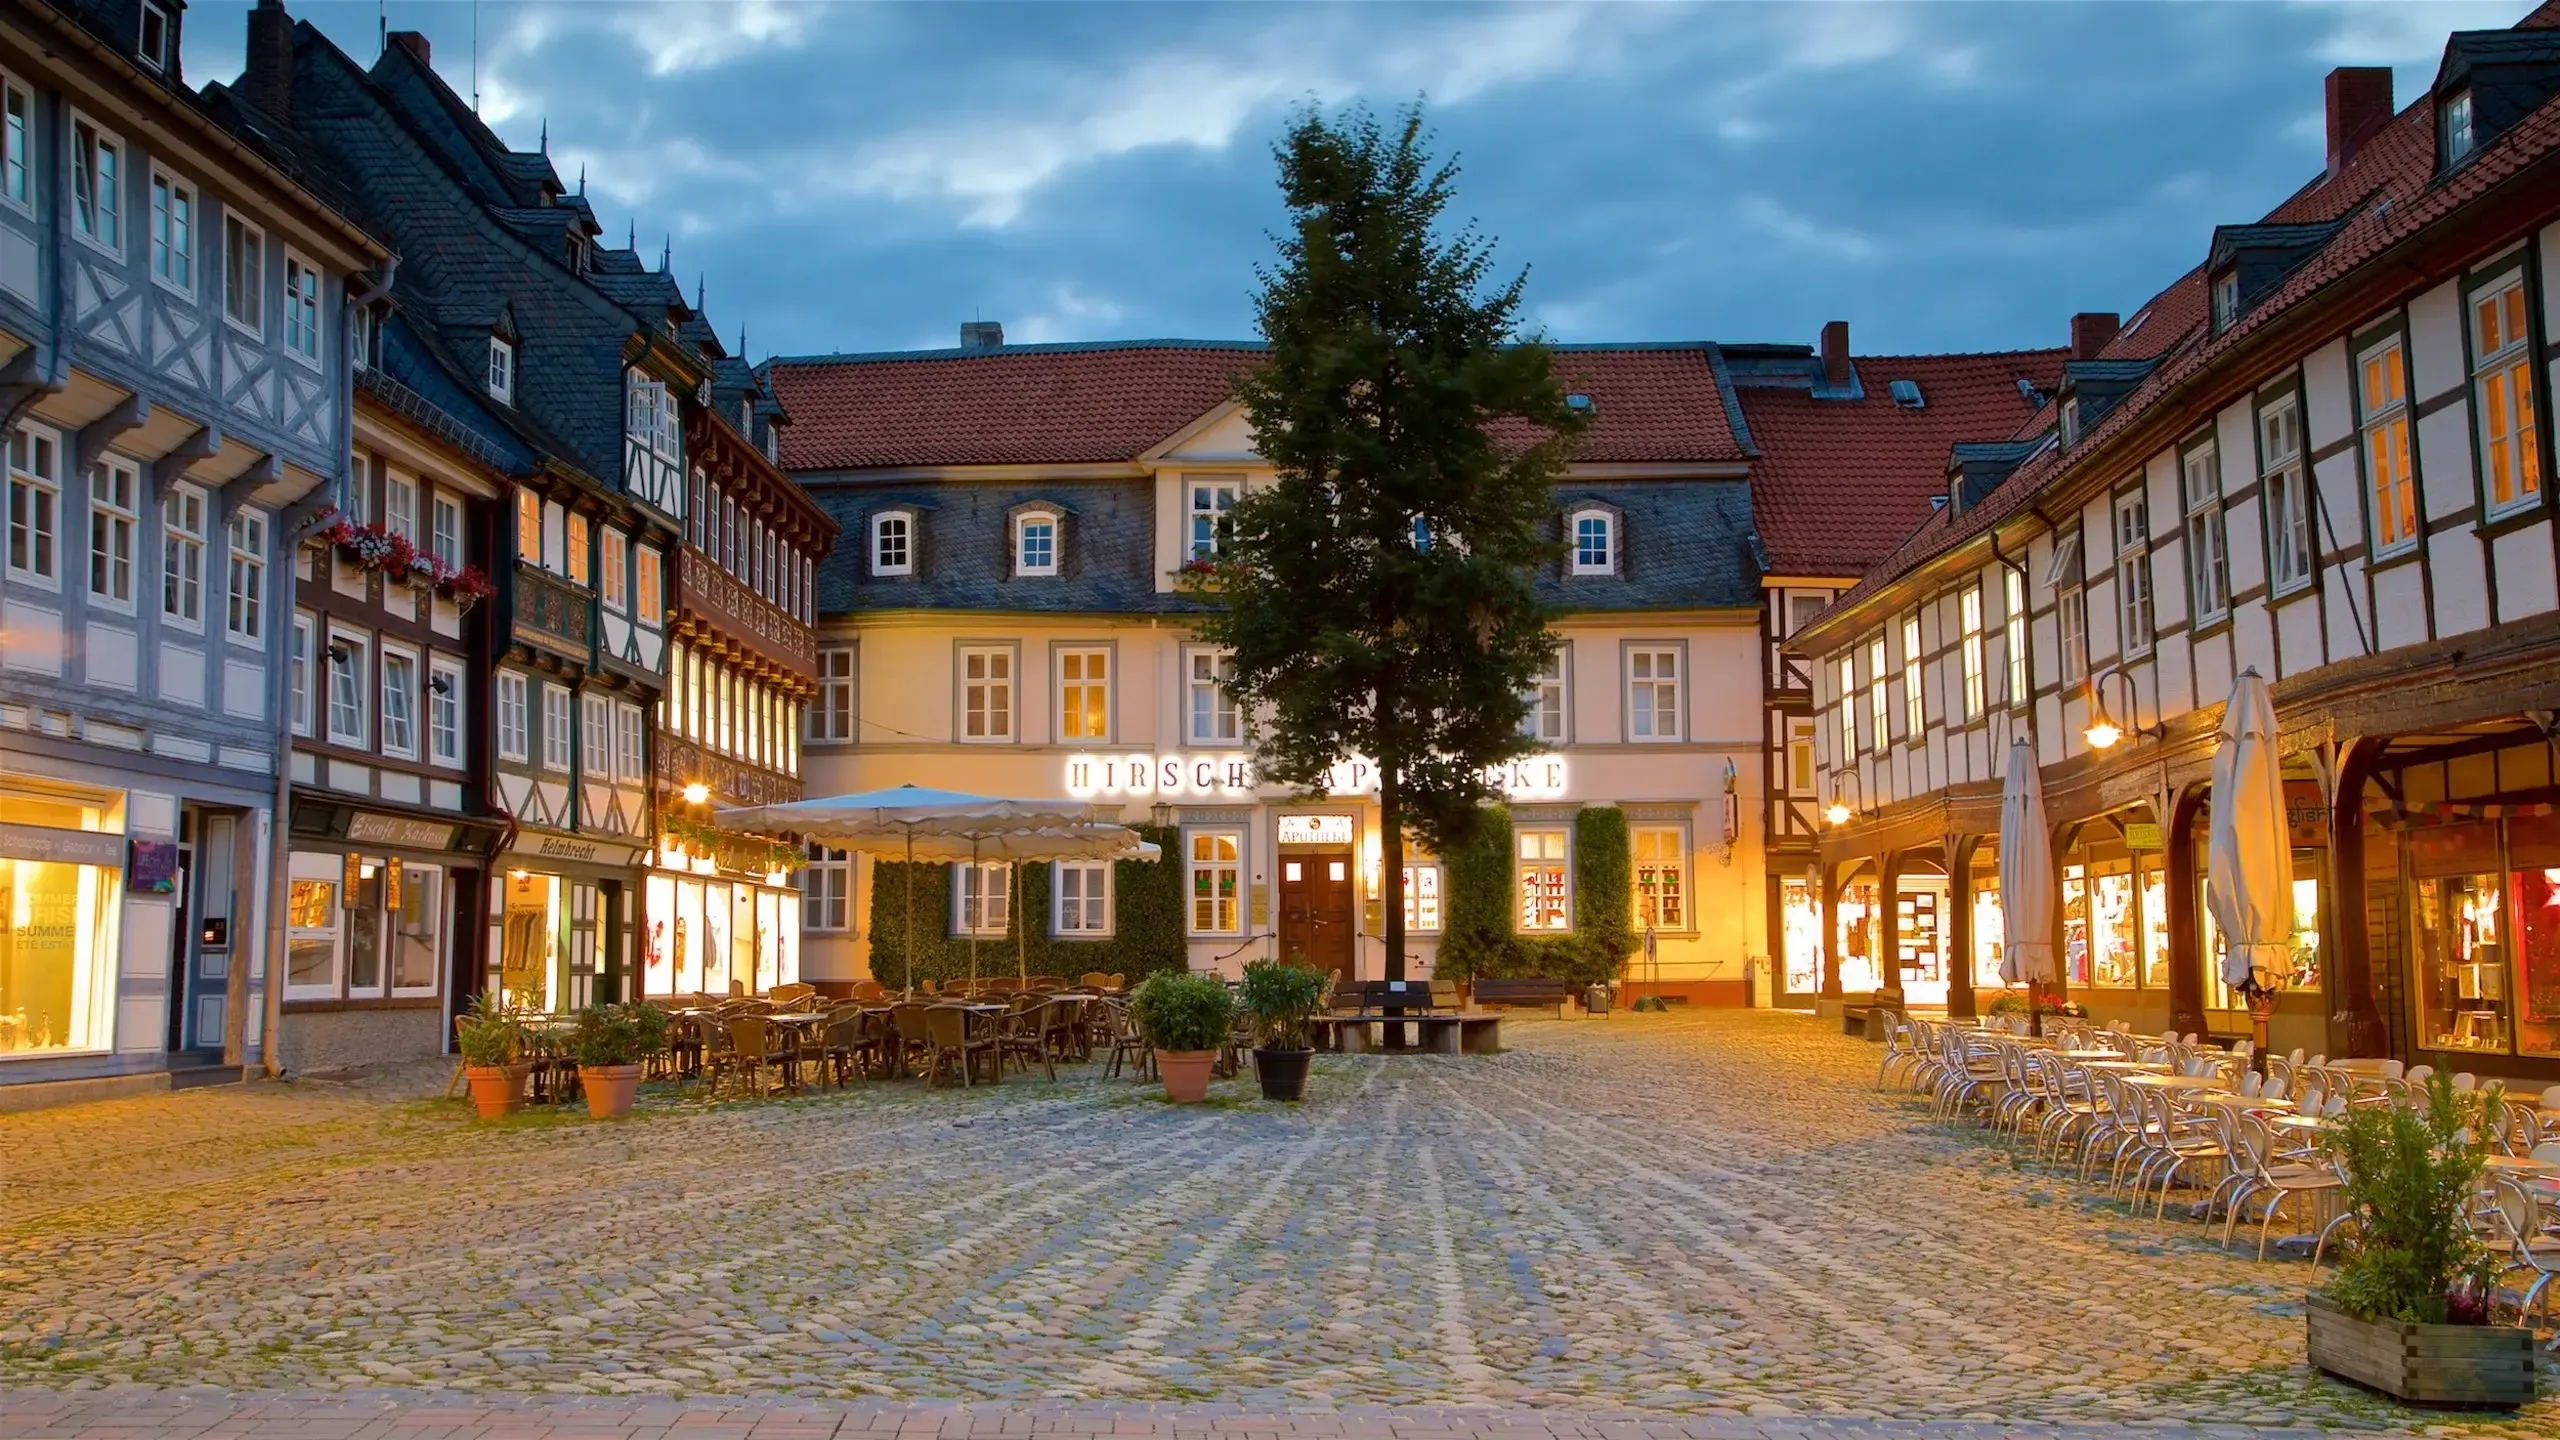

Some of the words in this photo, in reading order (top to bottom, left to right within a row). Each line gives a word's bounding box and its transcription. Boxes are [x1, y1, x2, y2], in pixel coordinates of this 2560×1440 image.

[1072, 762, 1244, 788] HIRSCH
[1319, 763, 1561, 788] APEKE
[16, 925, 75, 938] SUMME
